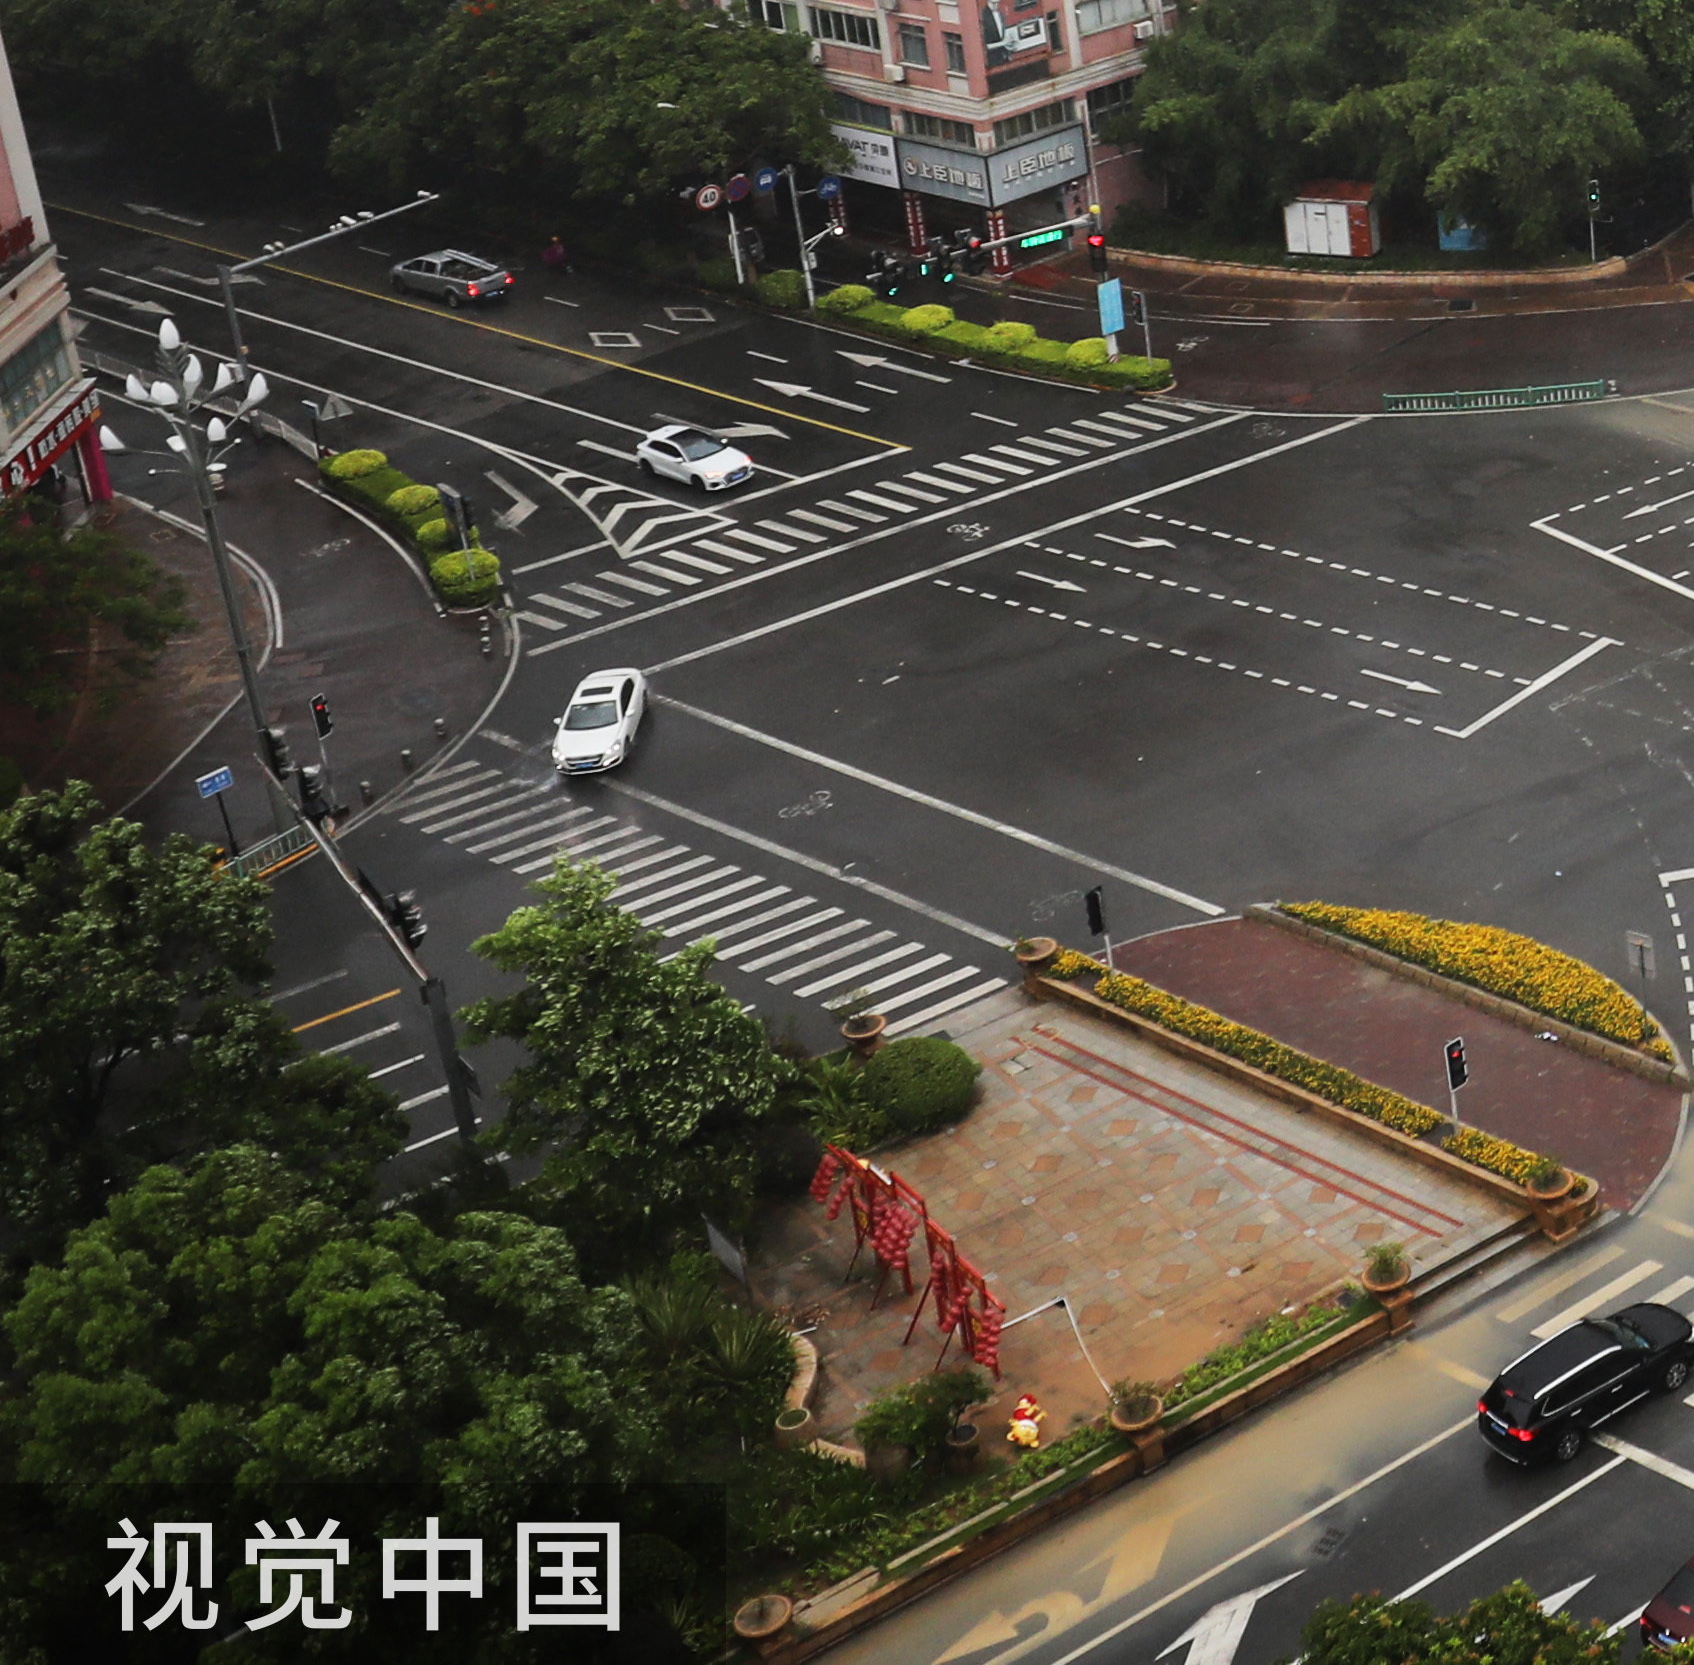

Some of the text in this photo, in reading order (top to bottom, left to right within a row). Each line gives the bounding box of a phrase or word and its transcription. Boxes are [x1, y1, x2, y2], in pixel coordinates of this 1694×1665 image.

[919, 162, 984, 191] 上臣地板
[1002, 141, 1075, 183] 上臣地板
[701, 190, 718, 204] 40
